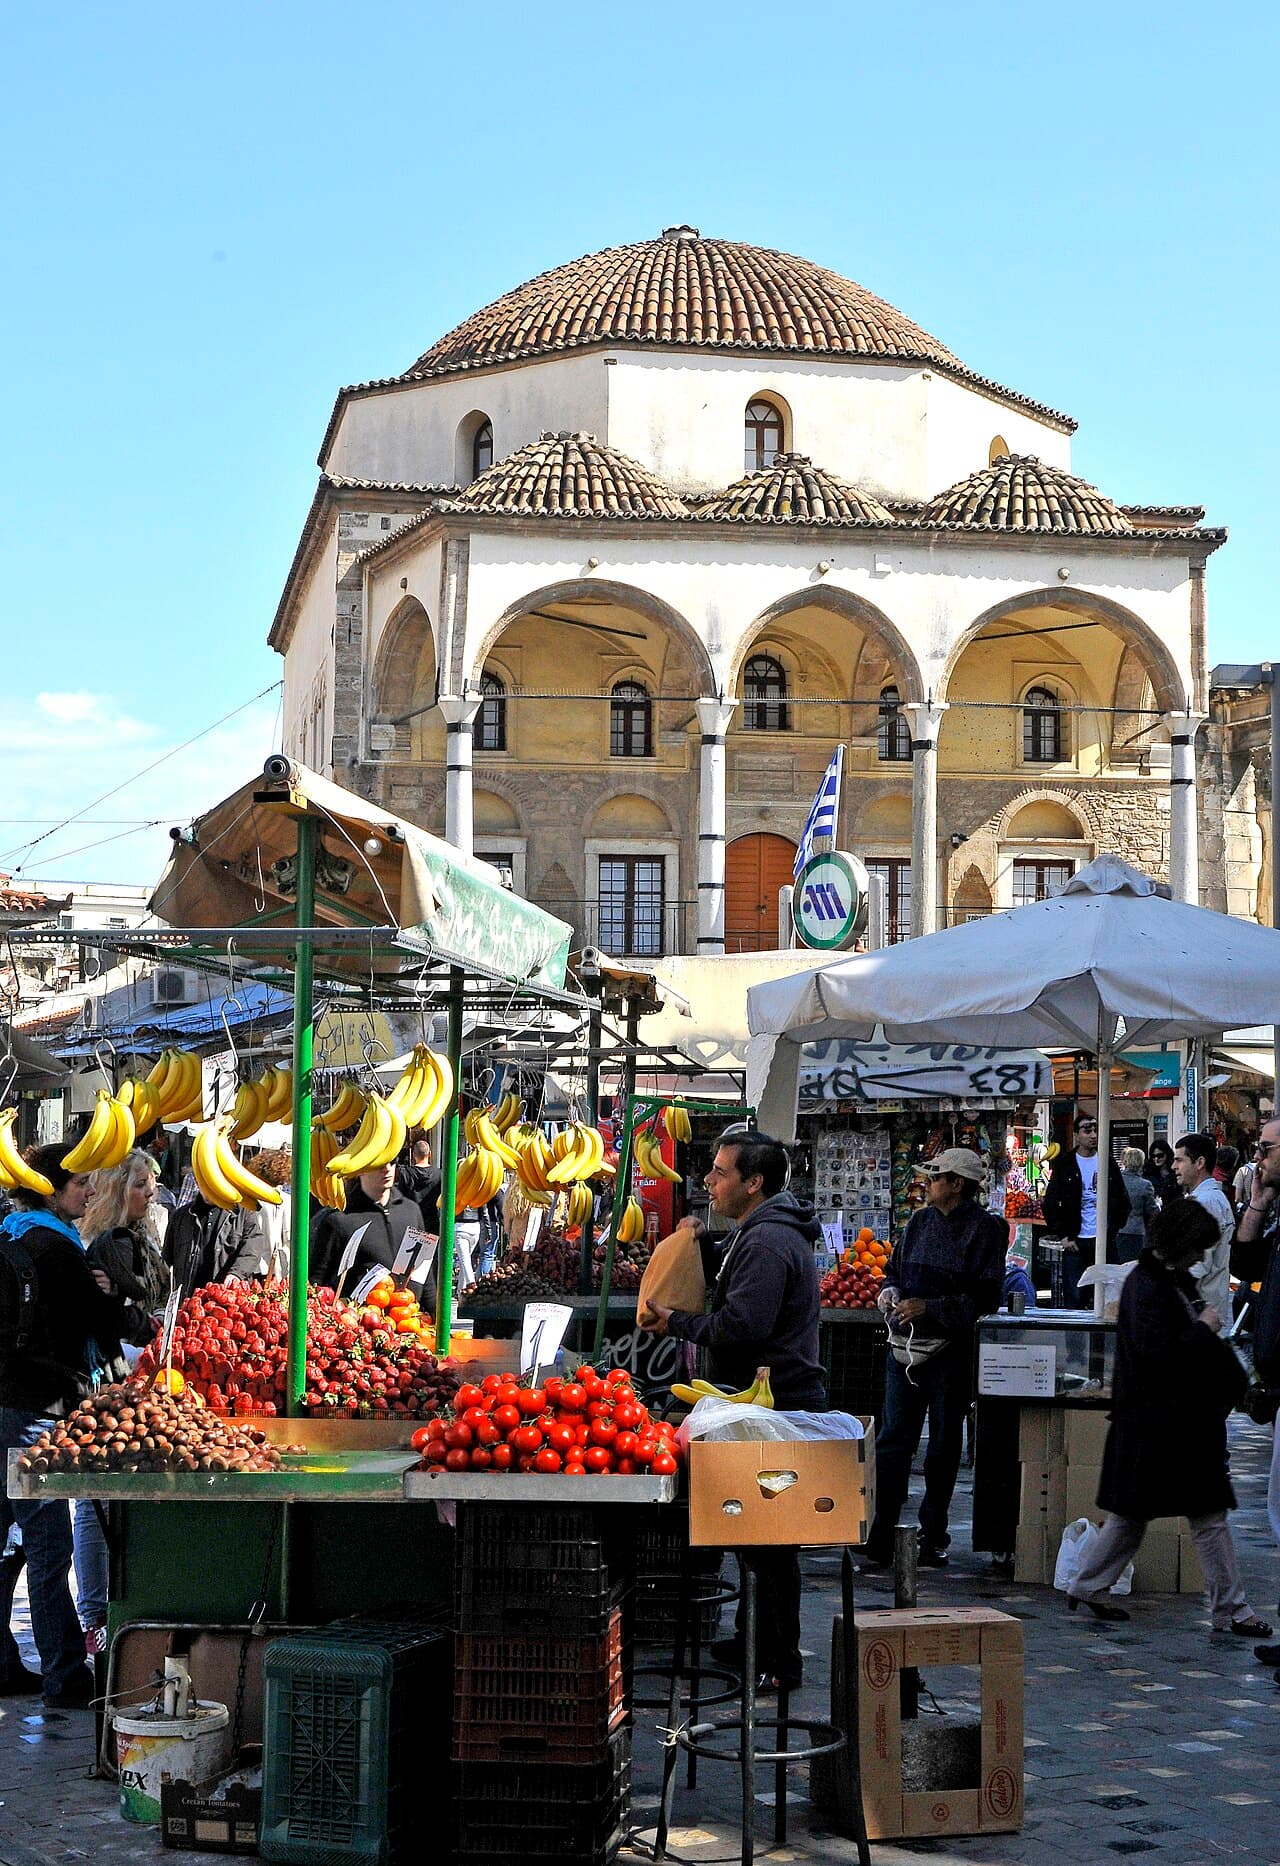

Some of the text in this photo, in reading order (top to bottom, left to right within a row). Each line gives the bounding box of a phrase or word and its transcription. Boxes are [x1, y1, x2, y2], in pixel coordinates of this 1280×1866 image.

[1154, 1079, 1173, 1087] ange
[1187, 1069, 1195, 1132] EXCHANGE
[400, 1241, 423, 1276] 1
[529, 1319, 547, 1369] 1
[181, 1798, 206, 1806] Cretan
